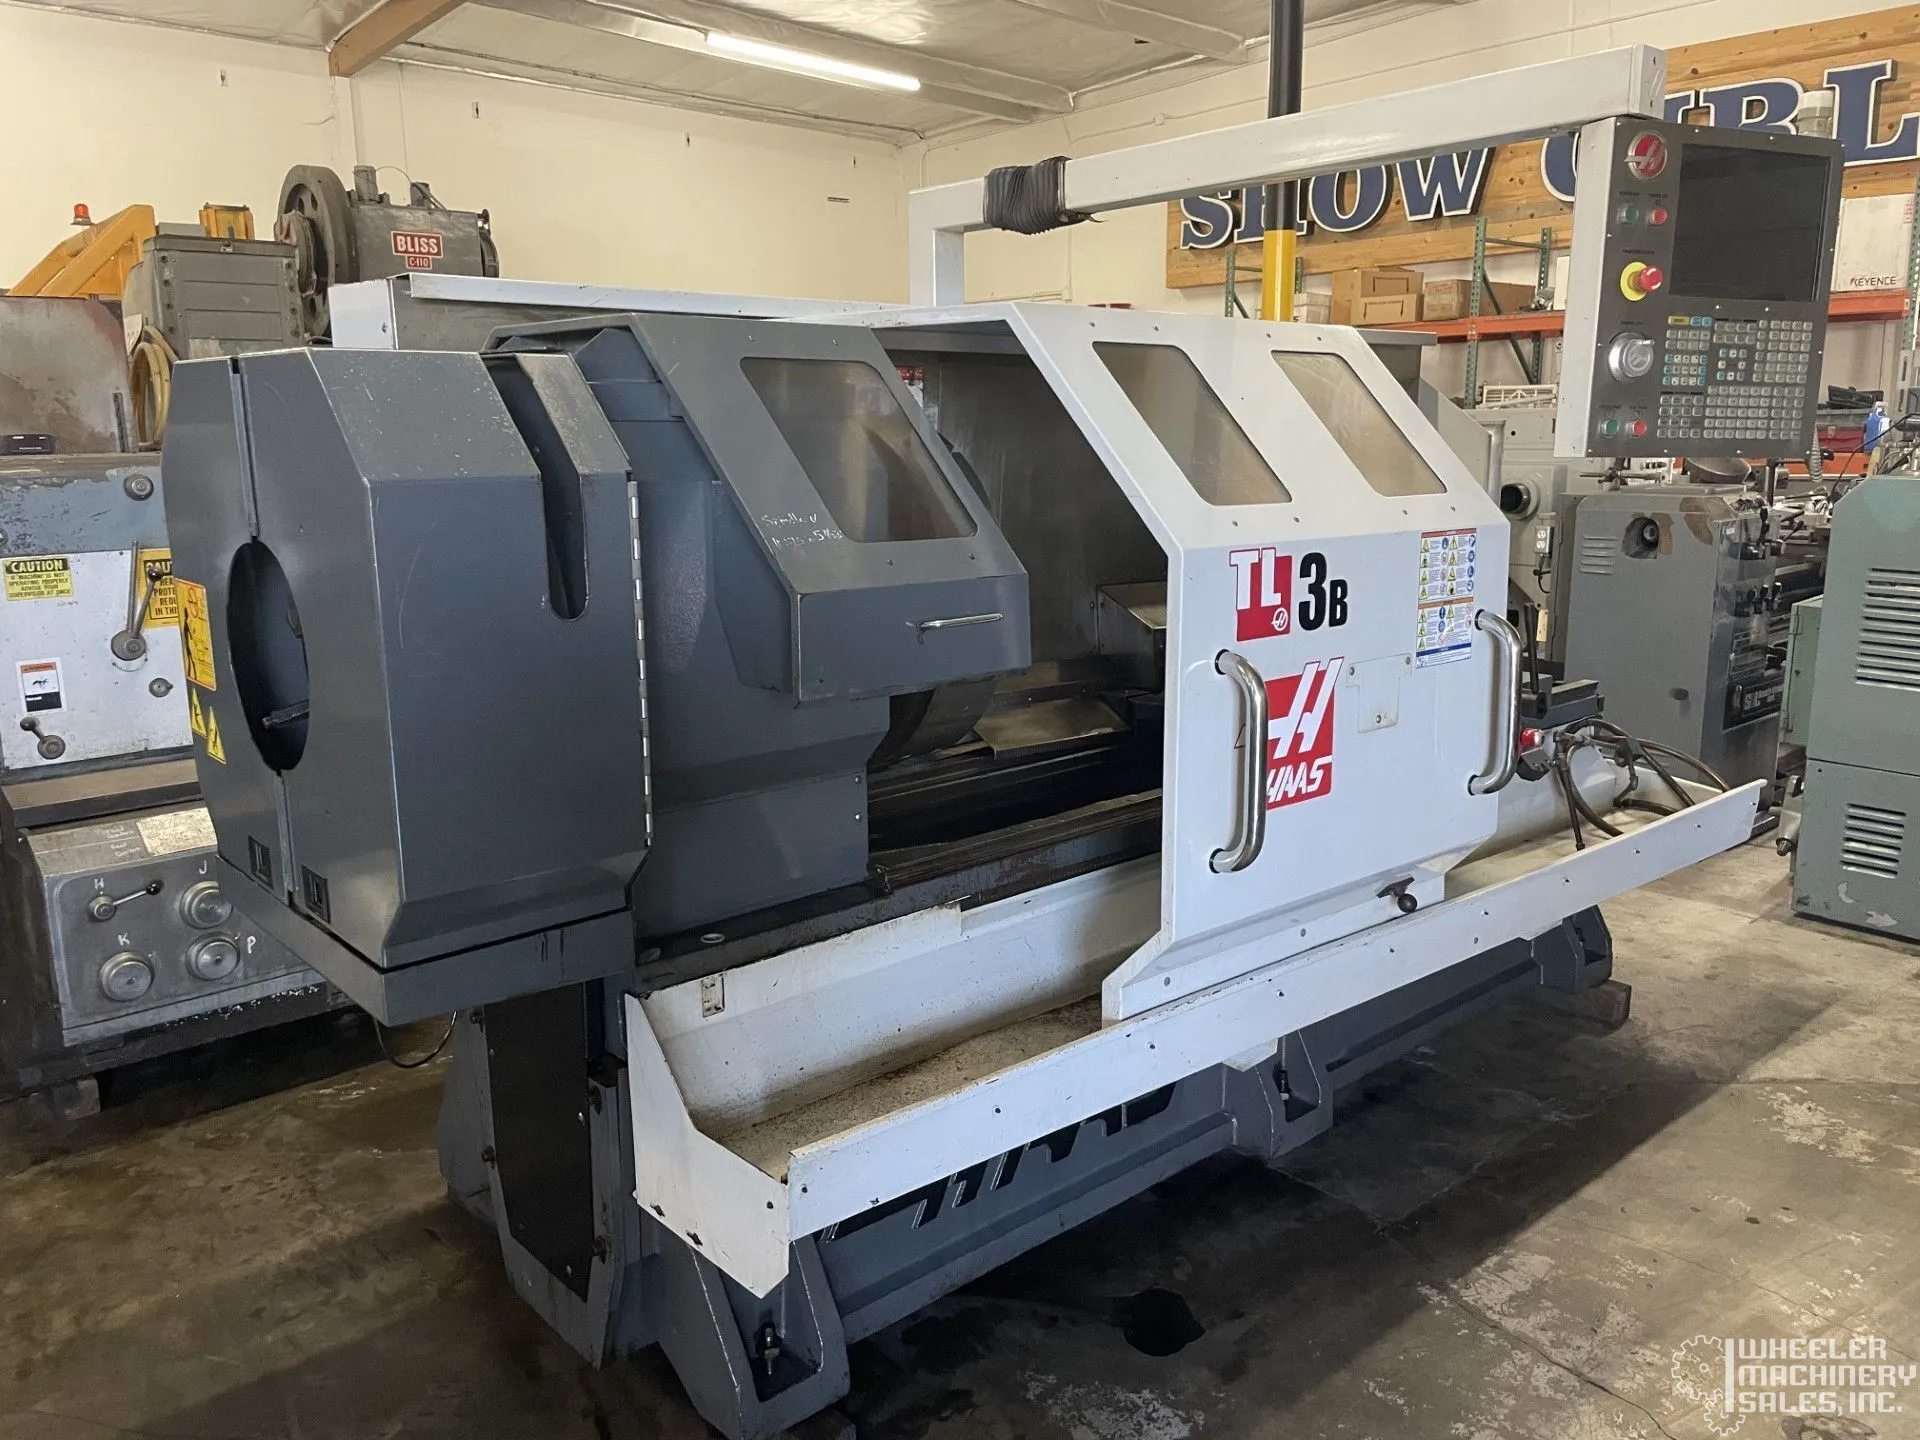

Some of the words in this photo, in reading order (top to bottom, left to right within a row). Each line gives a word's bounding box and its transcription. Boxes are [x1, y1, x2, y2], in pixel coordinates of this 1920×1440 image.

[396, 235, 438, 253] BLISS
[1850, 276, 1897, 287] KEYENCE
[11, 559, 63, 573] CAUTION
[1229, 547, 1282, 611] TL
[199, 860, 207, 874] J
[94, 878, 105, 890] H
[118, 933, 130, 946] K
[247, 936, 256, 953] P
